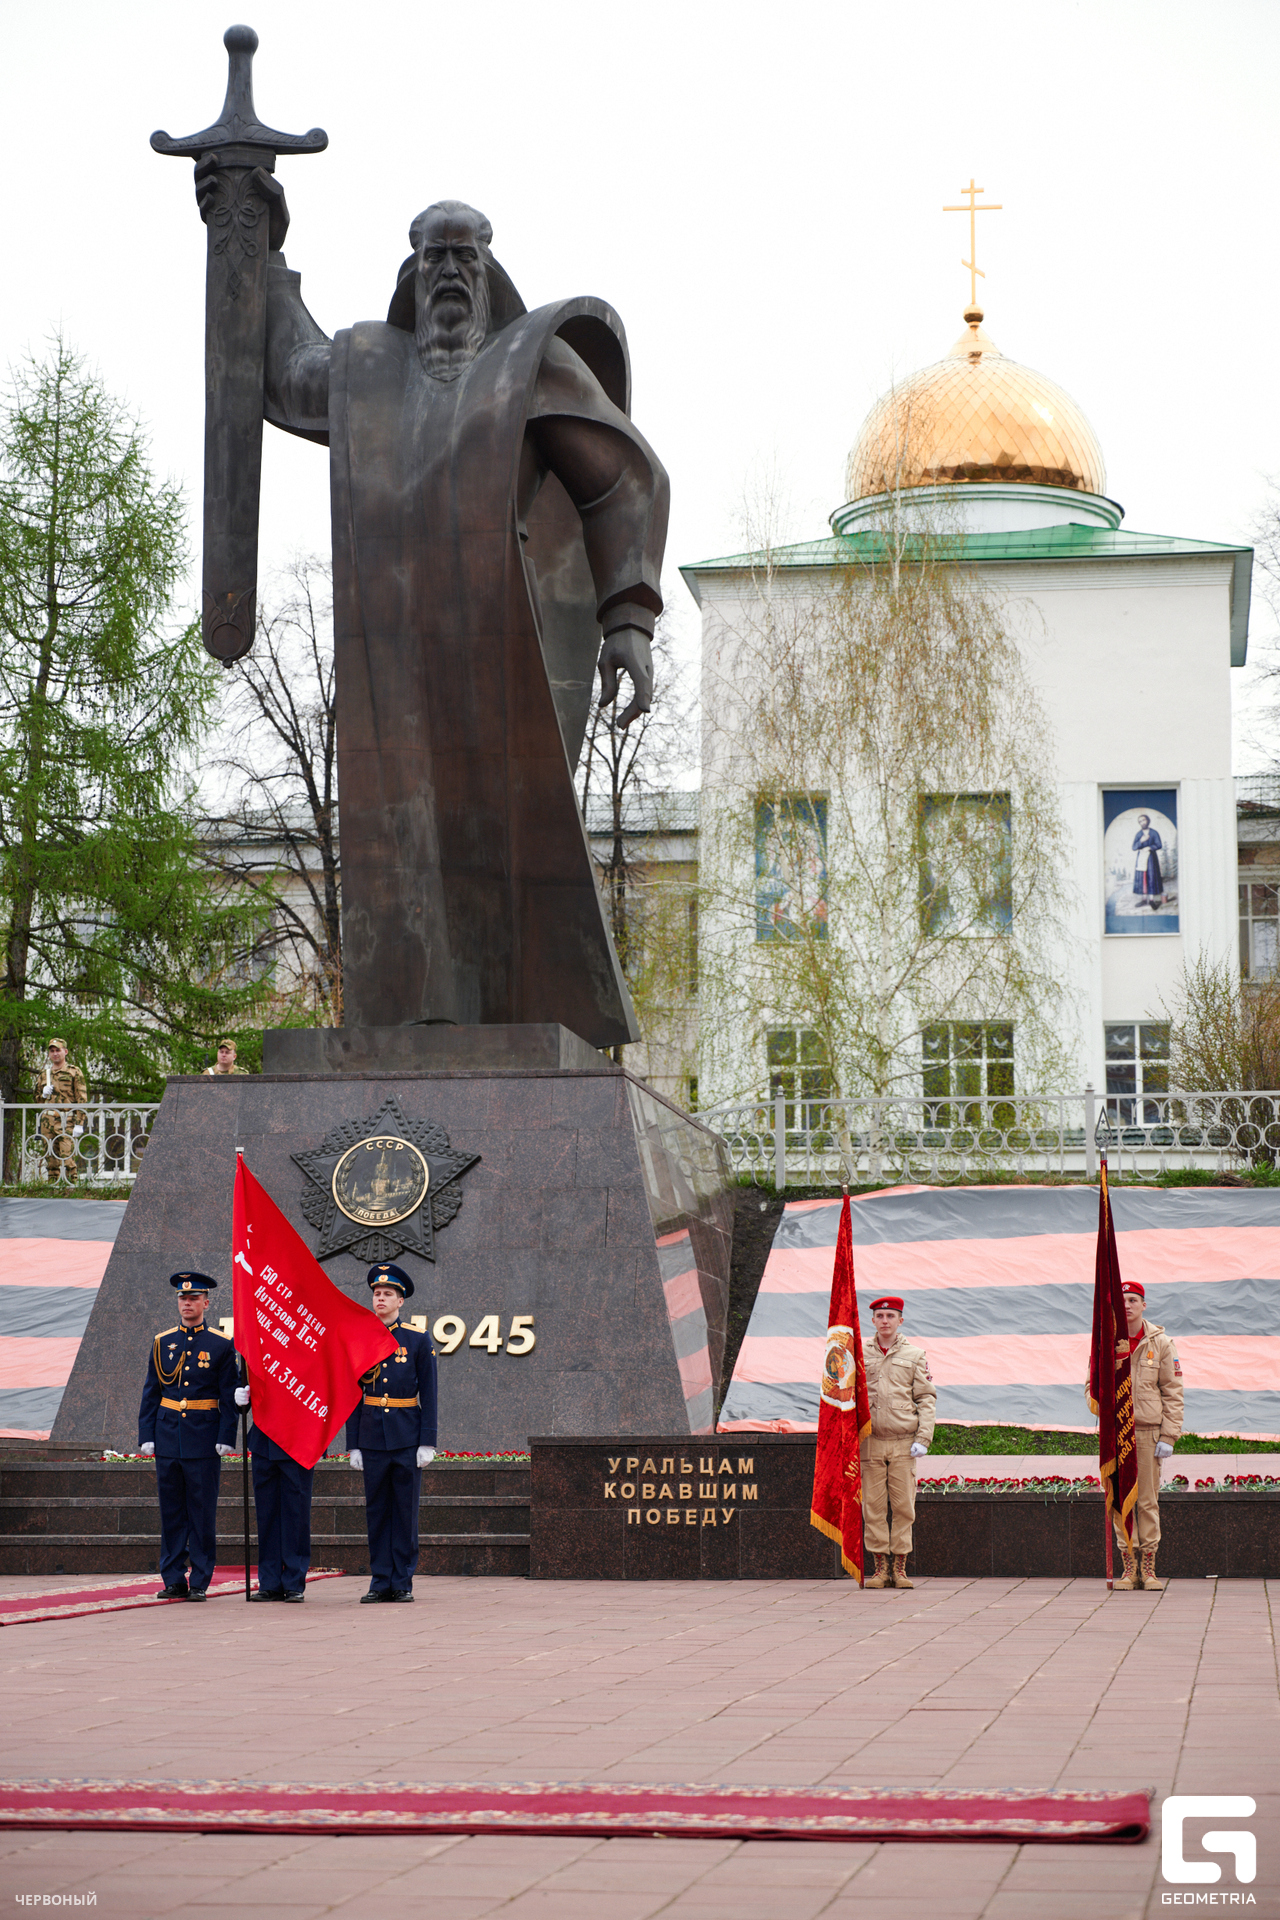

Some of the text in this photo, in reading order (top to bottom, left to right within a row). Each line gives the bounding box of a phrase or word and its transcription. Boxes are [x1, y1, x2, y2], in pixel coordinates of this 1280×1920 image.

[365, 1140, 404, 1151] СССР
[357, 1208, 395, 1220] ПОБЕДА
[260, 1265, 278, 1285] 150
[296, 1303, 326, 1336] ОРДЕНА
[608, 1457, 754, 1476] УРАЛЬЦАМ
[604, 1482, 758, 1500] КОВАВШИМ
[627, 1507, 736, 1526] ПОБЕДУ
